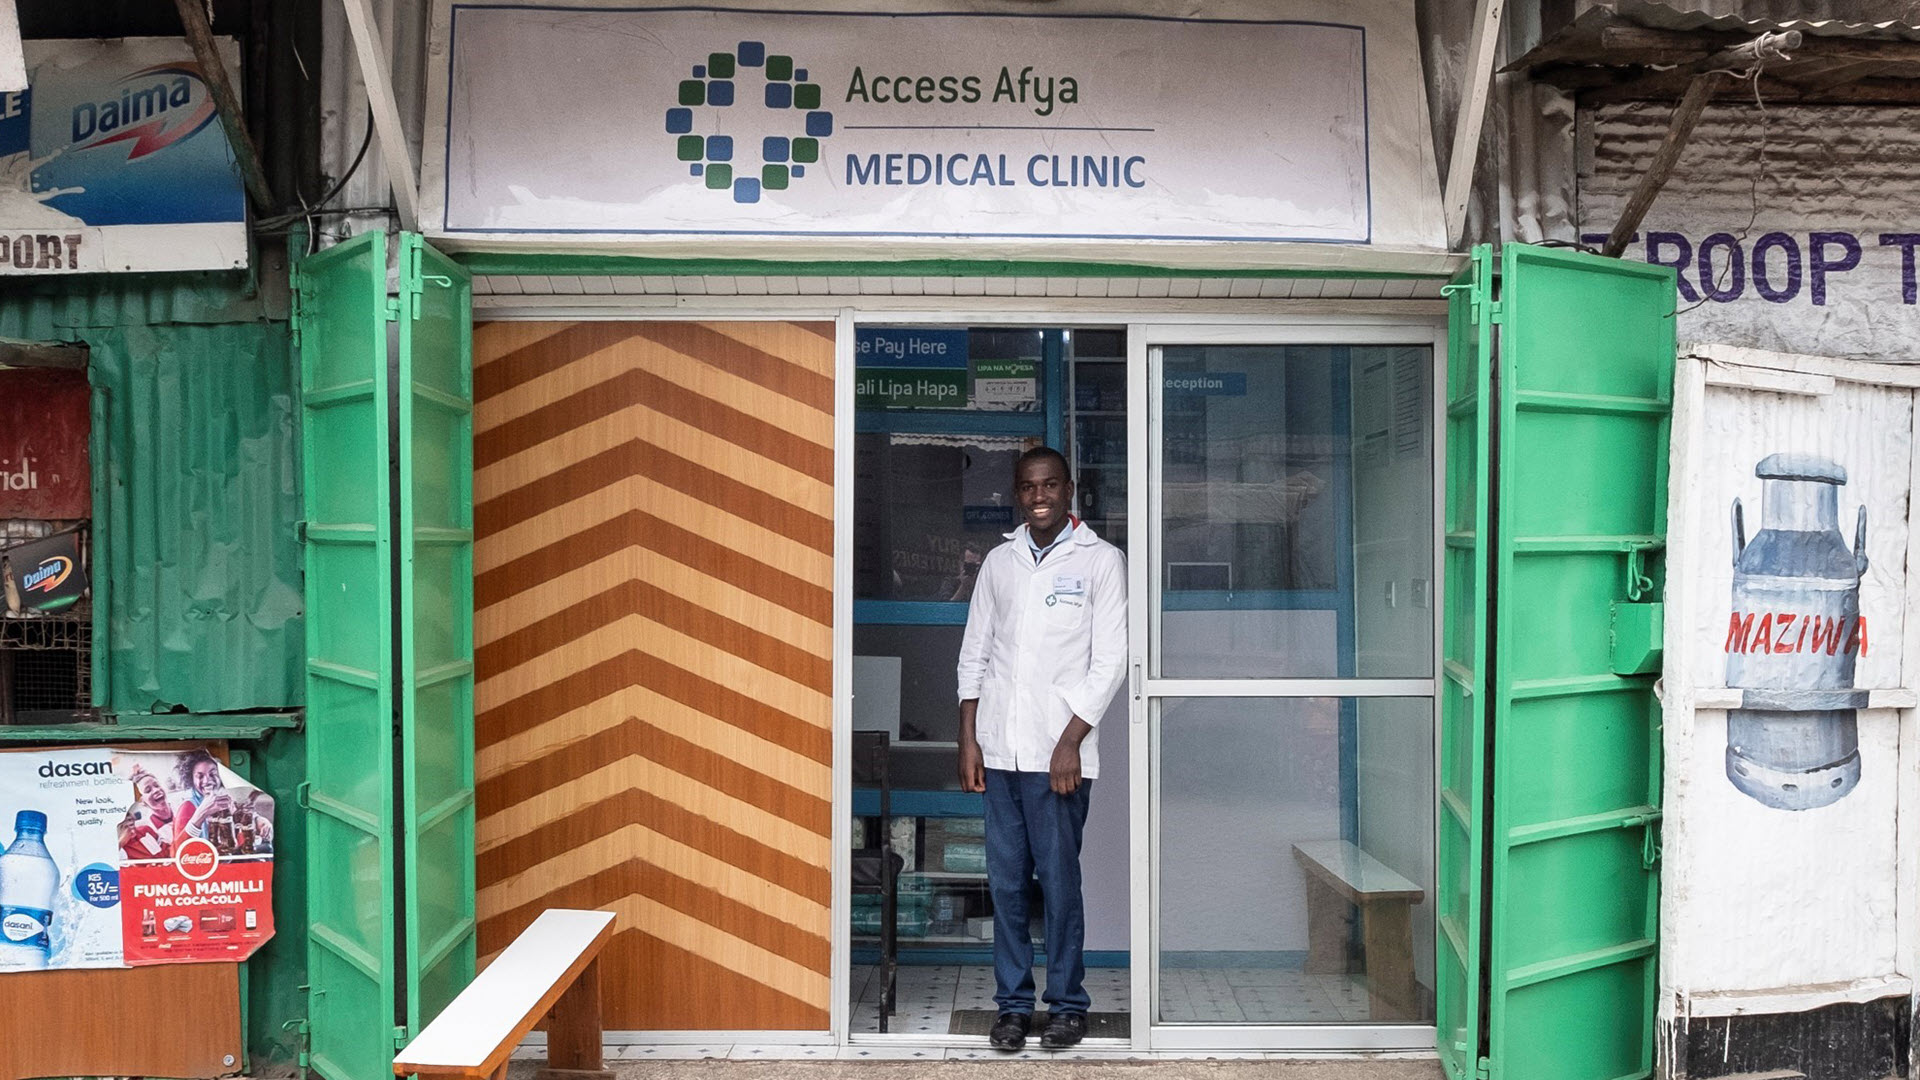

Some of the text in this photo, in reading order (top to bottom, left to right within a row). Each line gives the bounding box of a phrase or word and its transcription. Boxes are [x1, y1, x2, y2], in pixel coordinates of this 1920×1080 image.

[845, 66, 1078, 116] Access Afya
[0, 92, 22, 120] E
[71, 77, 191, 143] Daima
[846, 153, 1145, 188] MEDICAL CLINIC
[875, 337, 905, 359] Pay
[909, 337, 947, 355] Here
[879, 379, 913, 401] Lipa
[917, 379, 958, 402] Hapa
[1162, 377, 1223, 392] eception
[23, 560, 61, 589] Daima
[1724, 611, 1868, 658] MAZIWA
[38, 760, 113, 778] dasan
[76, 805, 127, 816] same trusted
[133, 880, 264, 898] FUNGA MAMILLI
[155, 894, 243, 907] NA COCA-COLA
